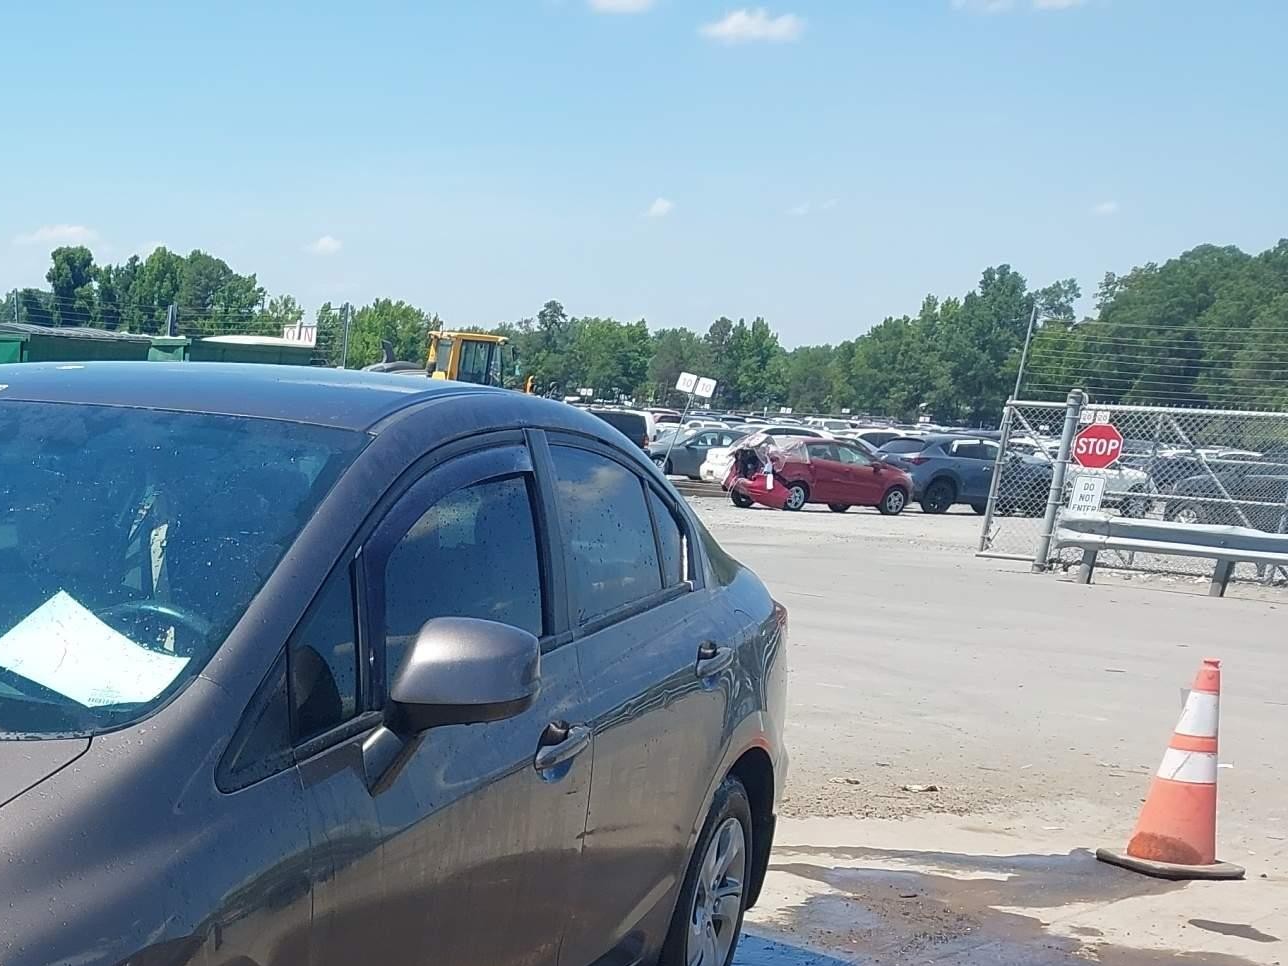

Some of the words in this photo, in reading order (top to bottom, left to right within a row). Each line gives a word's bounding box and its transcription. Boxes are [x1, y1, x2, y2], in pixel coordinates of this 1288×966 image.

[682, 377, 693, 388] 10
[701, 382, 712, 393] 10
[1077, 438, 1119, 456] STOP
[1084, 483, 1095, 491] DO
[1079, 494, 1095, 502] NOT
